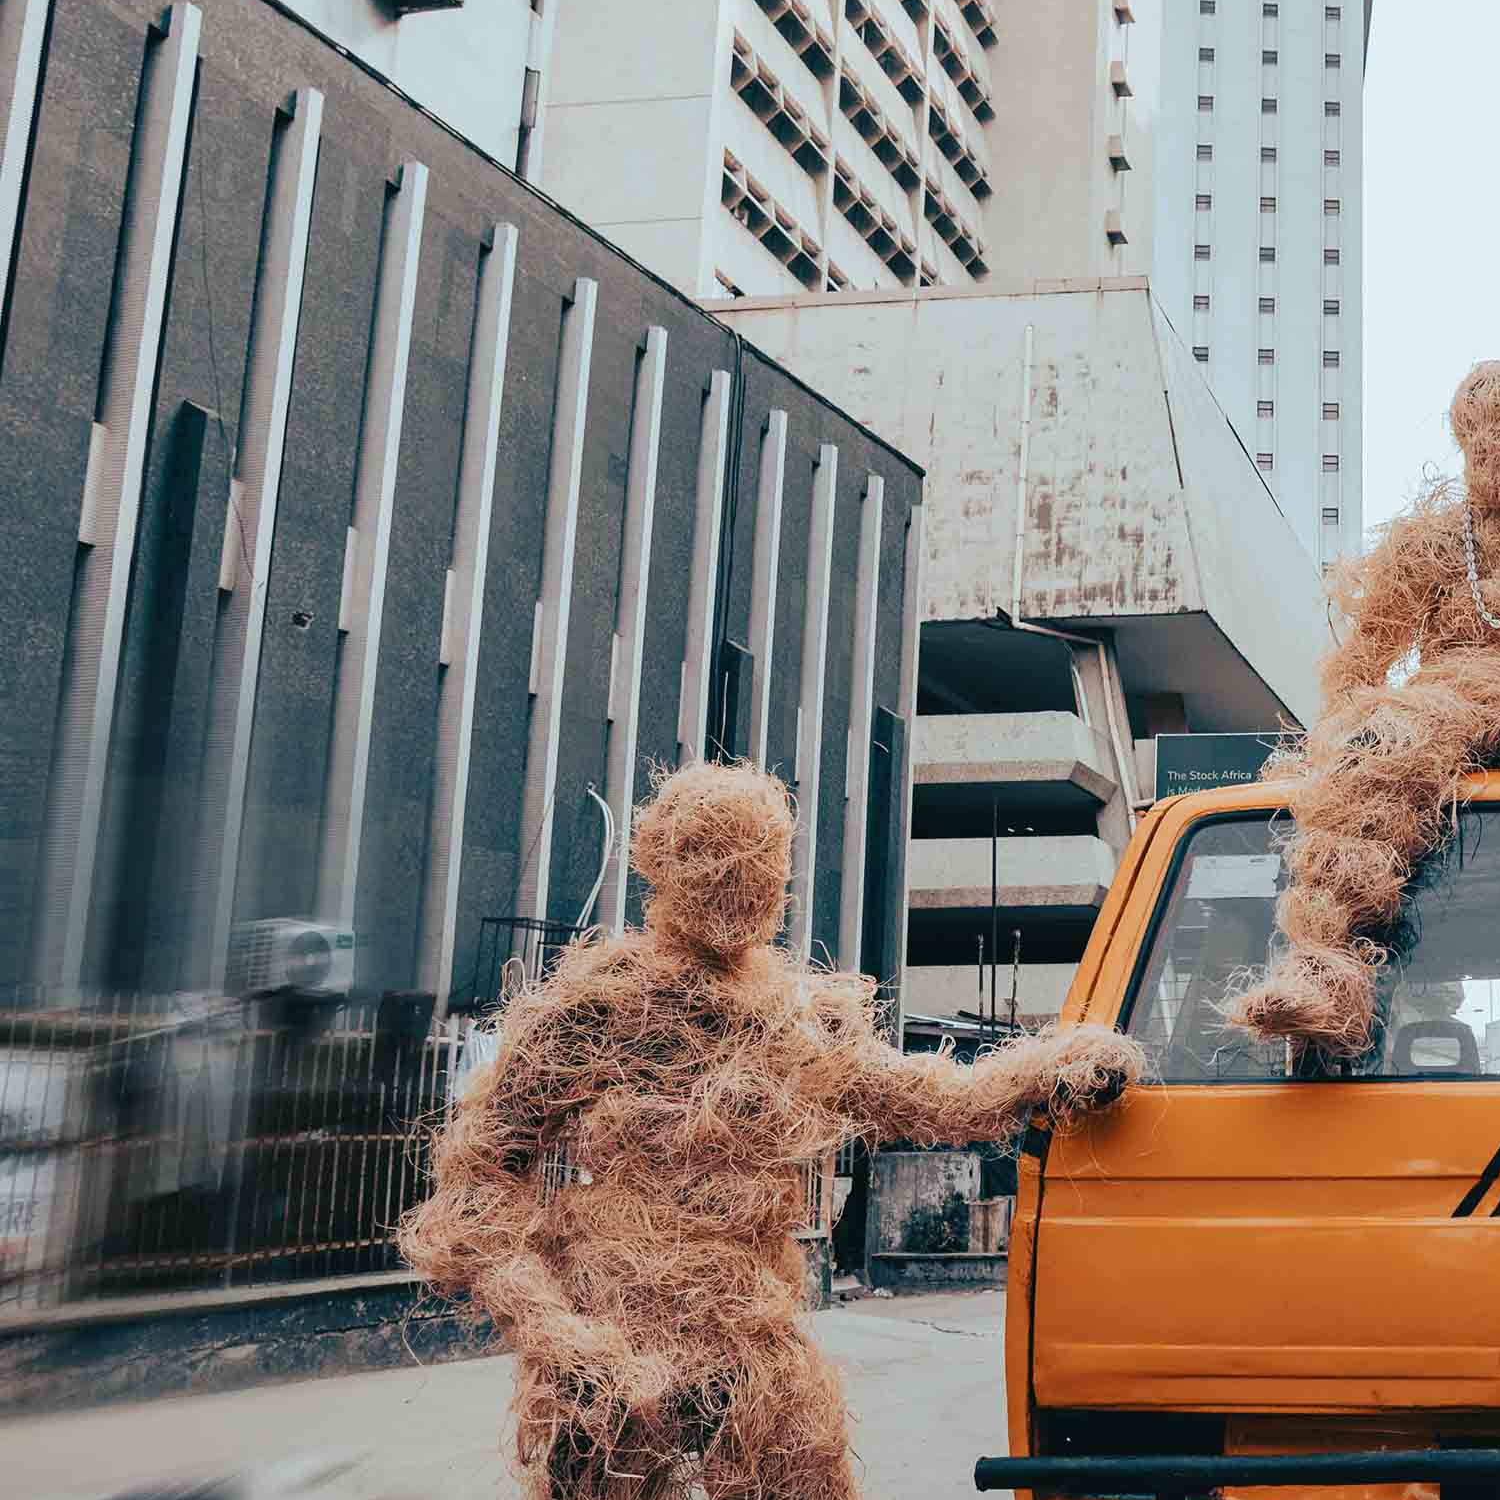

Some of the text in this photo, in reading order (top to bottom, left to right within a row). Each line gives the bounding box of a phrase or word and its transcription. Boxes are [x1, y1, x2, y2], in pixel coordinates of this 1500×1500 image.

[1167, 769, 1252, 781] The Stock Africa
